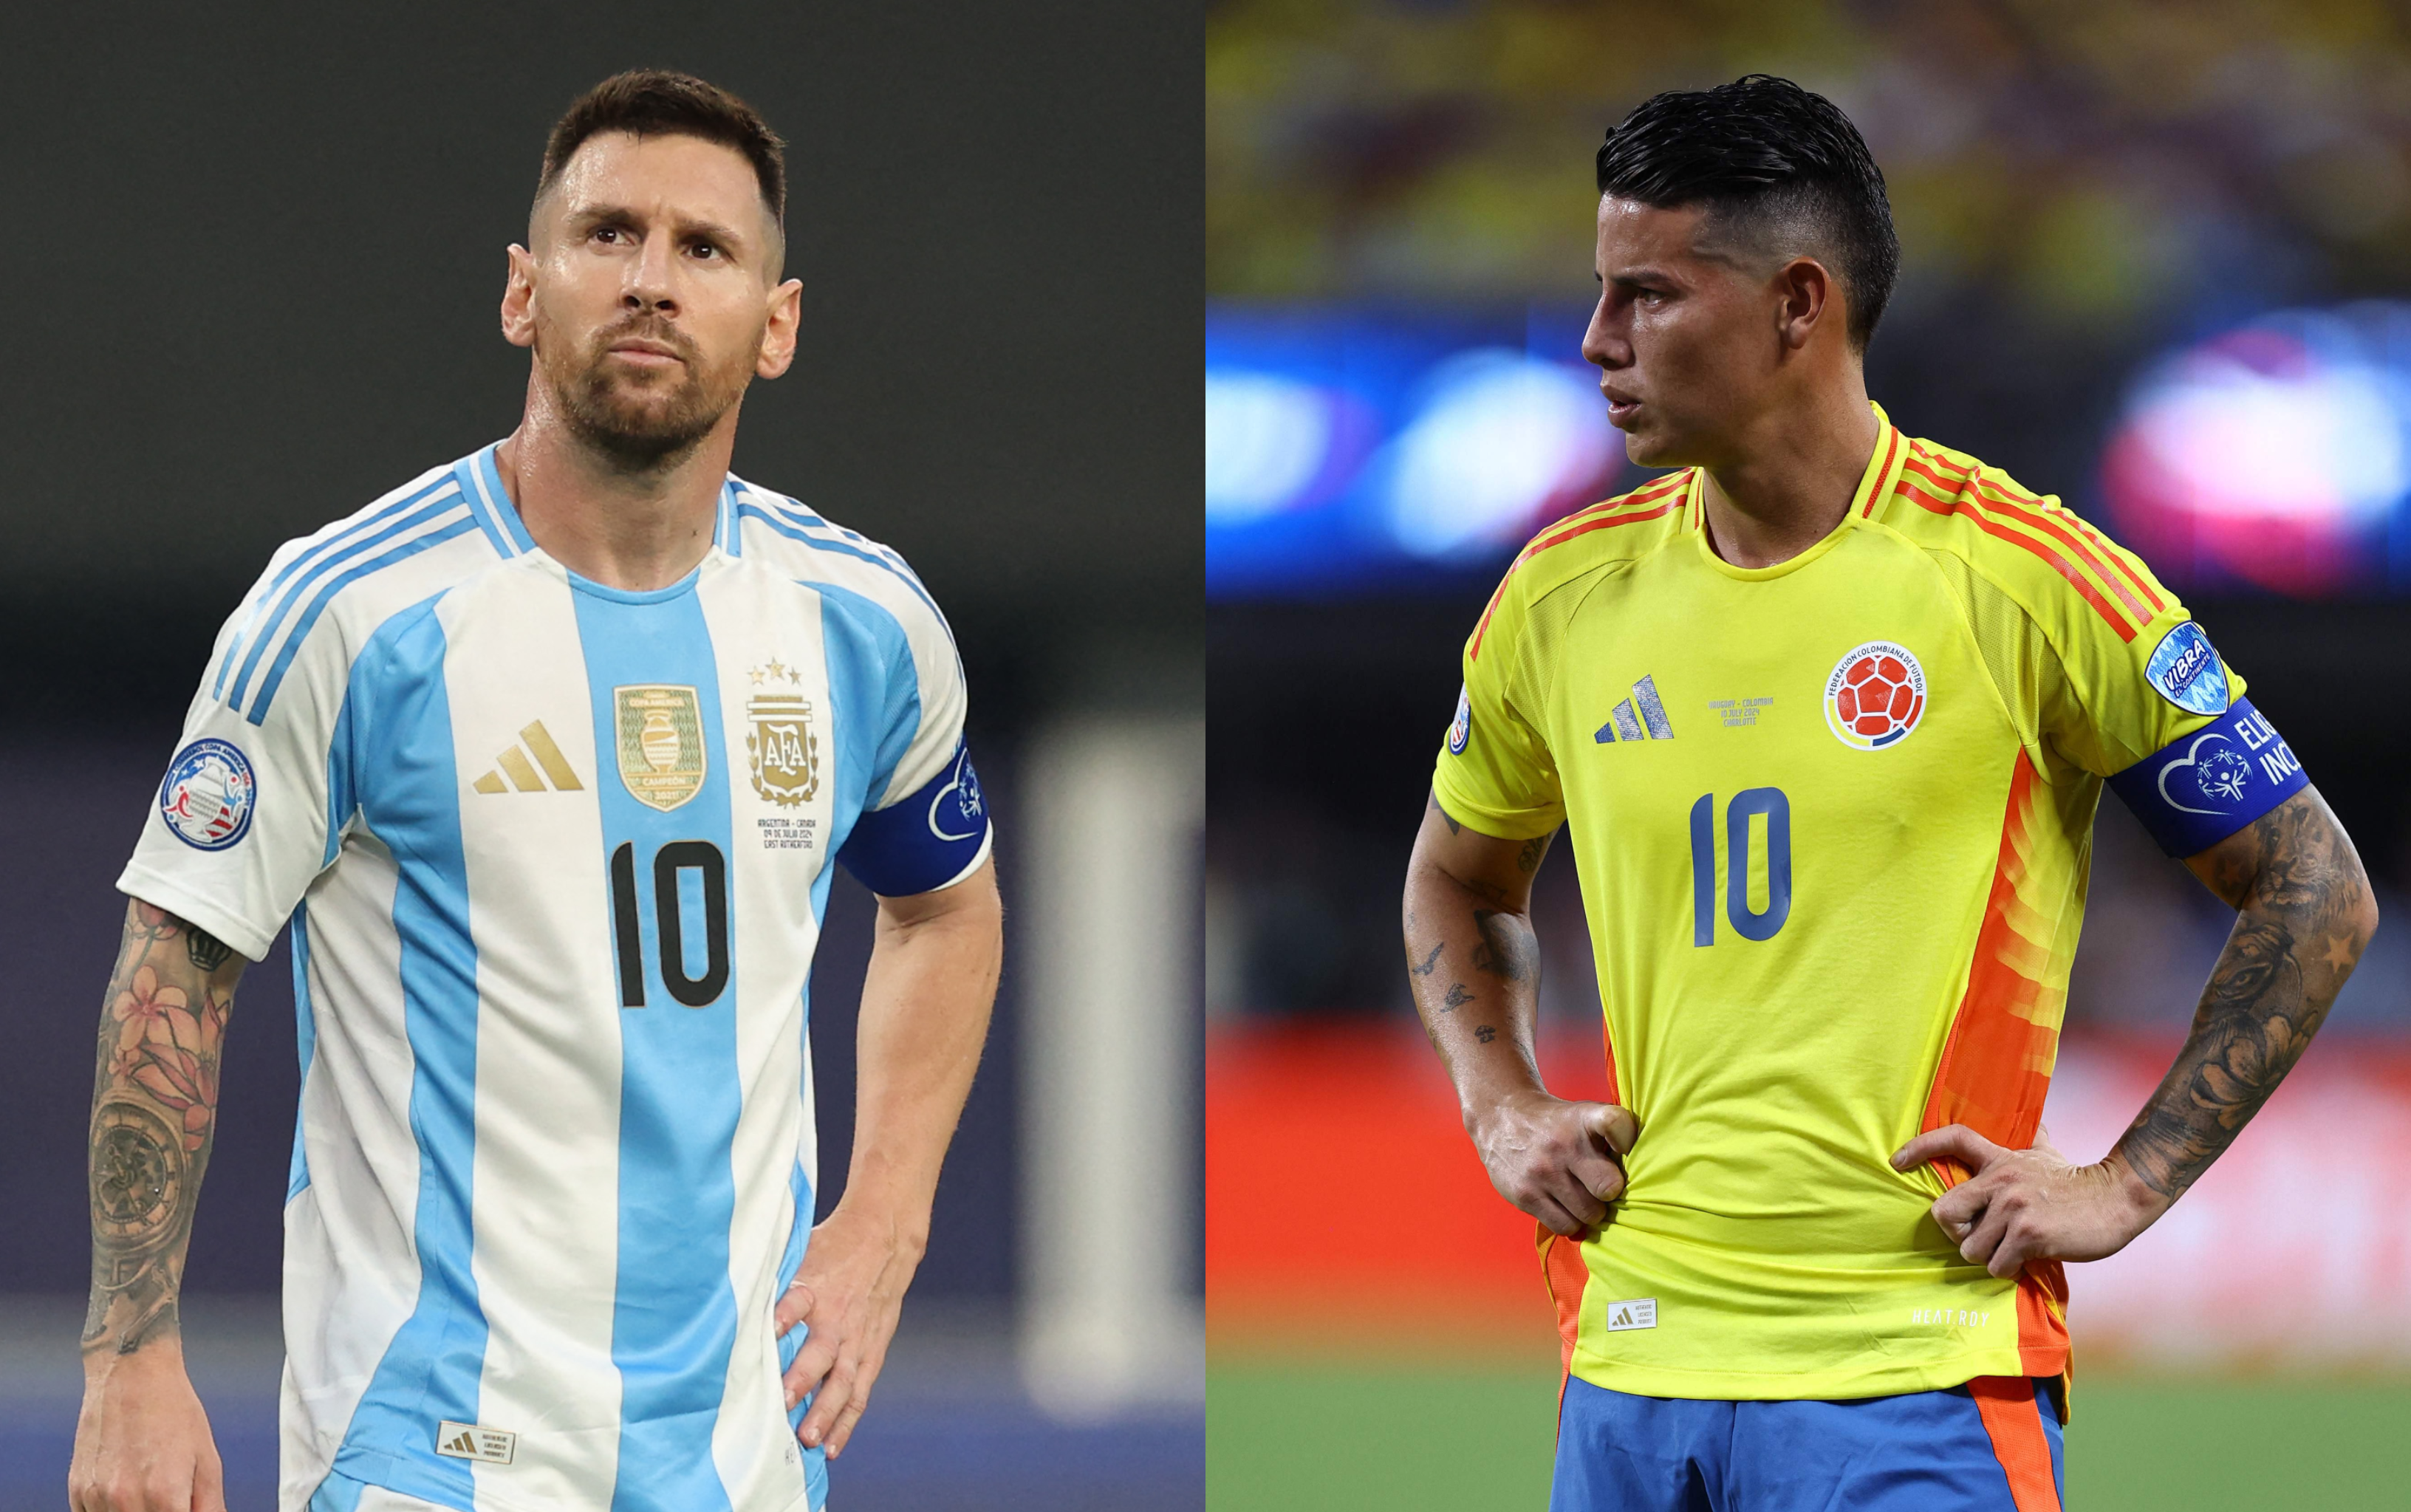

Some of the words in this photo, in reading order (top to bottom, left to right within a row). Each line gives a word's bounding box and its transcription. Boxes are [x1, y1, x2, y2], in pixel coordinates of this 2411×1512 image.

[1857, 645, 1904, 660] COLOMBIANA
[1904, 656, 1912, 666] DE
[1909, 663, 1923, 693] FÚTBOL
[2164, 638, 2206, 691] VIBRA
[2175, 687, 2183, 698] EL
[2183, 652, 2211, 688] CONTINENTE
[1709, 699, 1735, 709] URUGUAY
[1743, 697, 1774, 707] COLOMBIA
[1720, 709, 1727, 718] 10
[1728, 708, 1742, 717] JULY
[1744, 708, 1759, 716] 2024
[1723, 716, 1757, 727] CHARLOTTE
[765, 723, 807, 776] AFA
[758, 818, 790, 828] ARGENTINA
[796, 819, 816, 828] CANADA
[783, 829, 798, 838] JULIO
[764, 840, 779, 849] EAST
[1690, 787, 1791, 948] 10
[611, 841, 729, 1007] 10
[1912, 1309, 1989, 1327] HEAT.RDY
